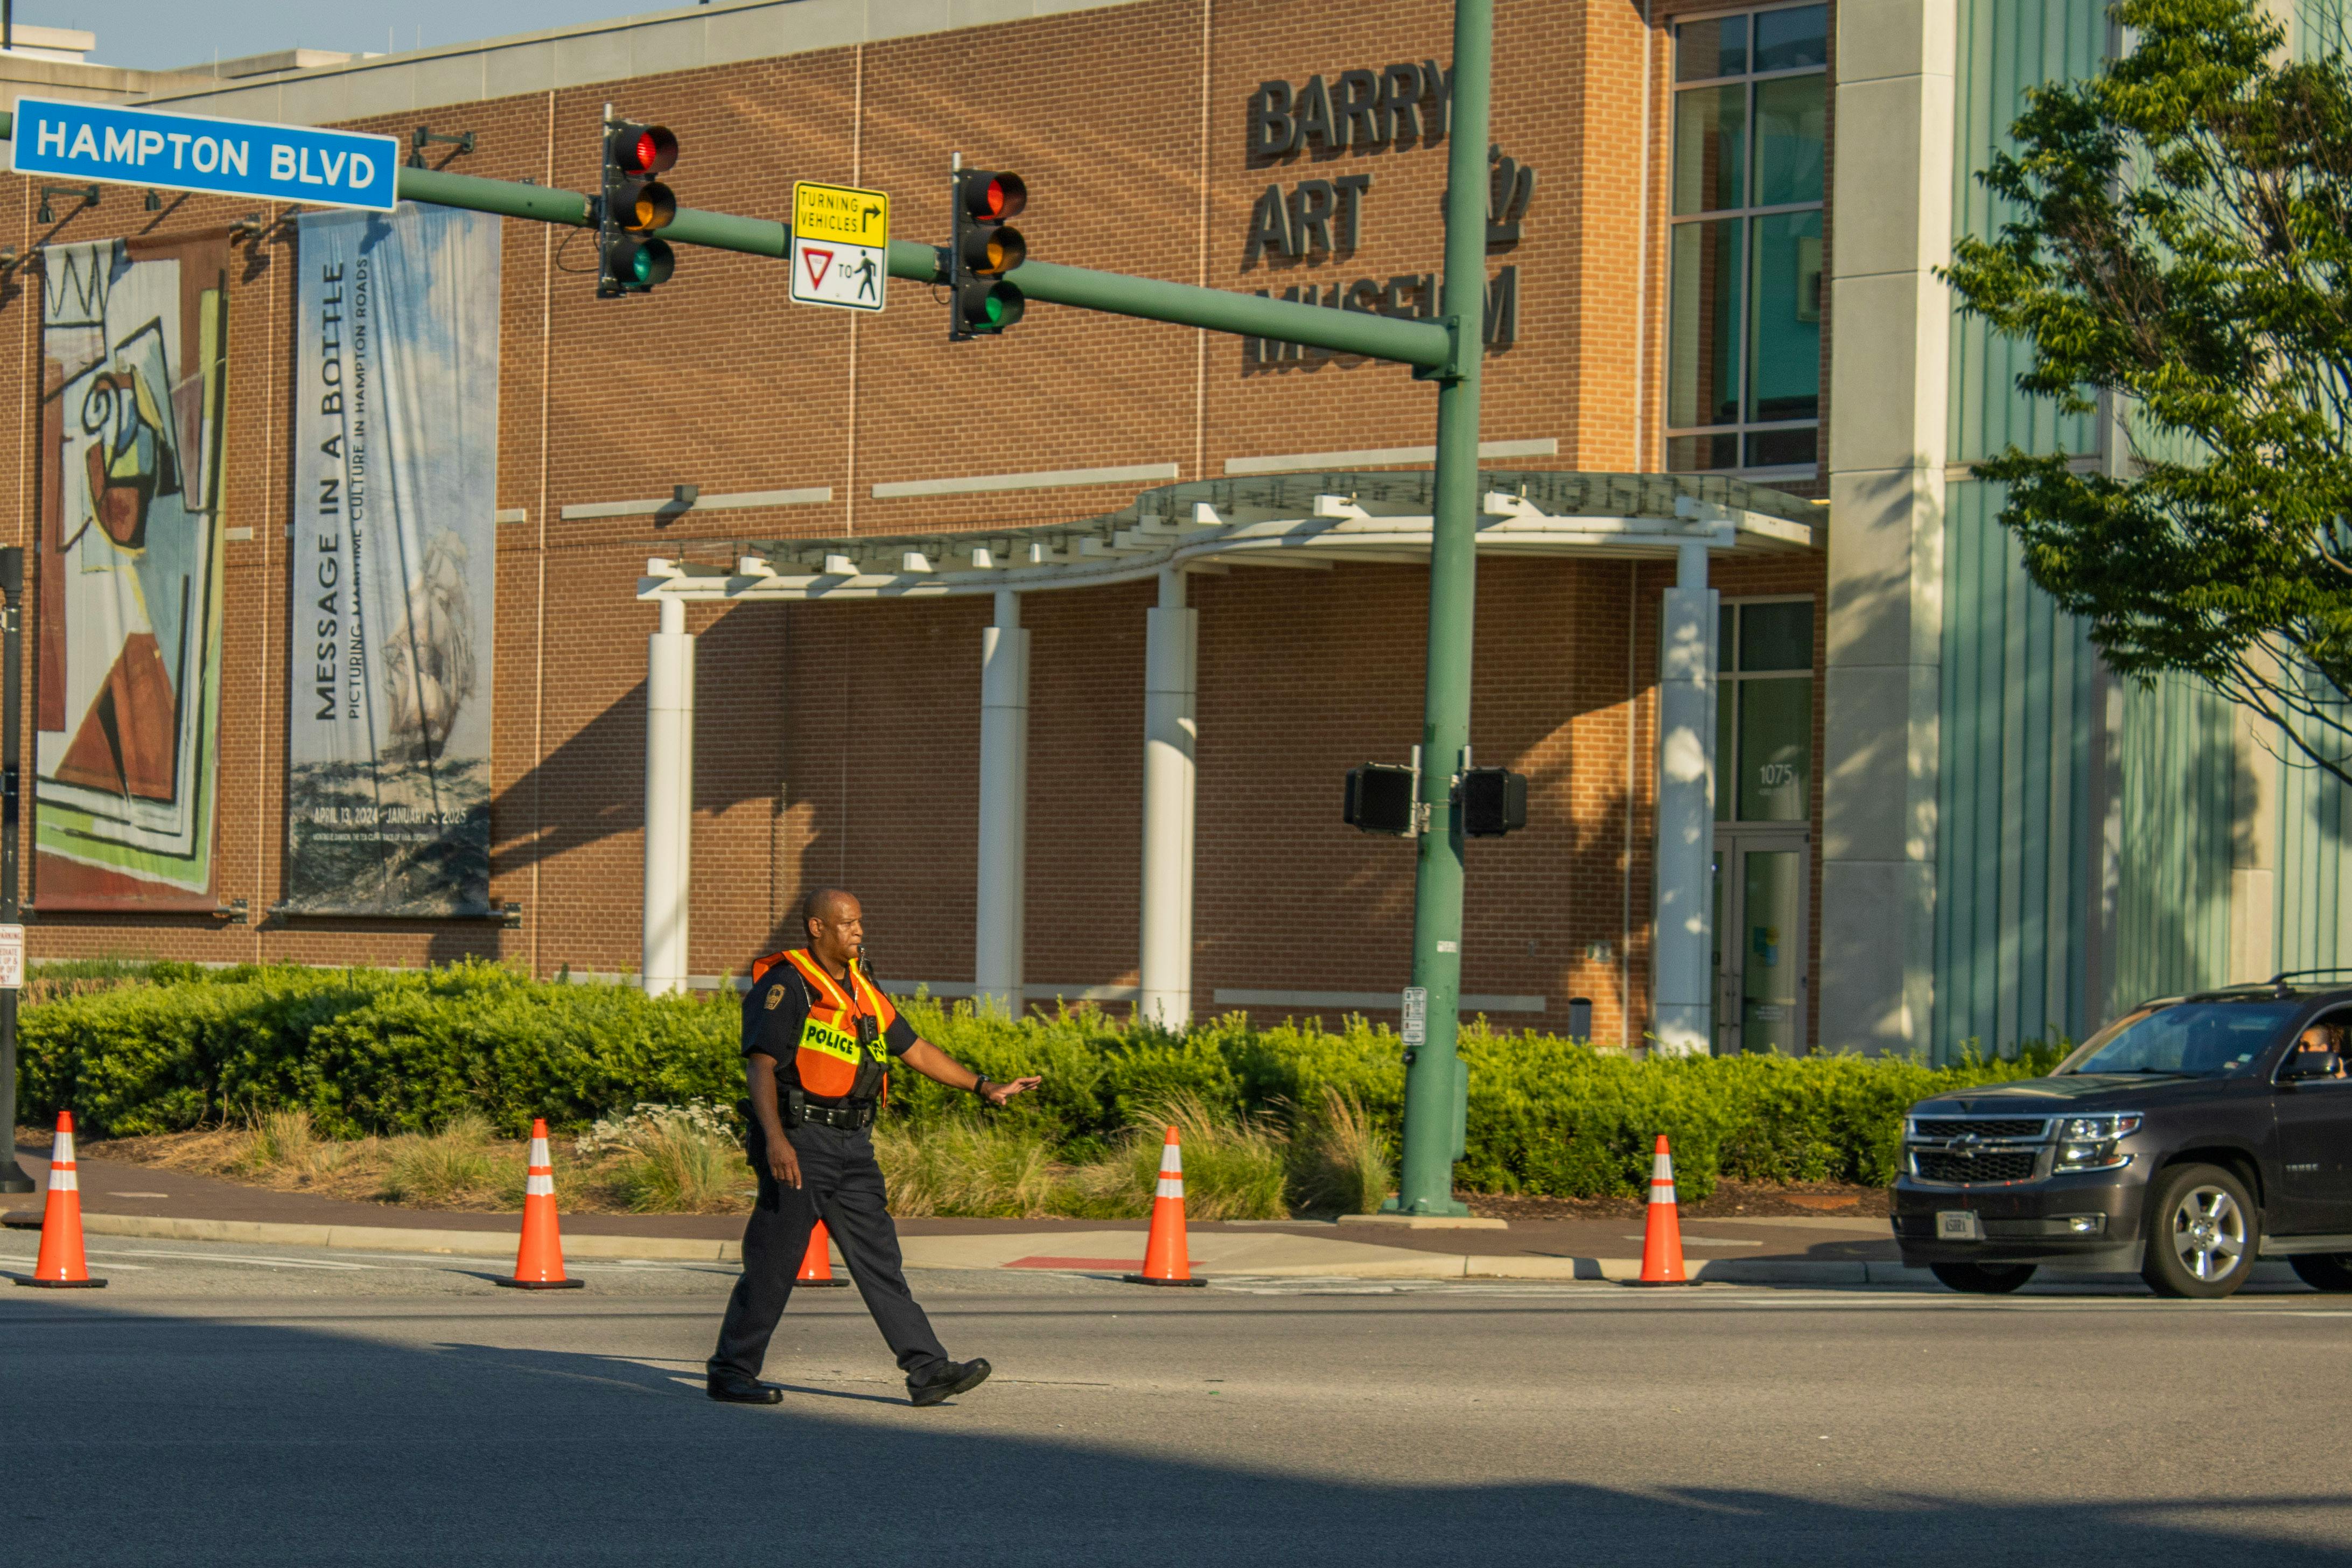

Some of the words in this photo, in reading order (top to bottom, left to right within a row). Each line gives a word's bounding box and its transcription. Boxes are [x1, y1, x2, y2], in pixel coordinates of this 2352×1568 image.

[1257, 59, 1453, 156] BARRY
[37, 119, 249, 176] HAMPTON
[270, 144, 375, 188] BLVD
[800, 191, 858, 213] TURNING
[800, 211, 857, 232] VEHICLES
[1246, 173, 1374, 258] ART
[355, 258, 368, 318] ROADS
[838, 264, 852, 278] TO
[321, 262, 344, 415] BOTTLE
[354, 324, 366, 414] HAMPTON
[321, 434, 341, 458] A
[354, 420, 365, 437] IN
[319, 478, 339, 515] IN
[351, 445, 364, 520] CULTURE
[316, 533, 339, 720] MESSAGE
[349, 623, 363, 719] PICTURING
[1760, 764, 1793, 785] 1075
[313, 807, 338, 824] APRIL
[355, 807, 378, 824] 2024
[386, 807, 426, 824] JANUARY
[442, 808, 467, 825] 2025
[807, 1025, 853, 1055] POLICE
